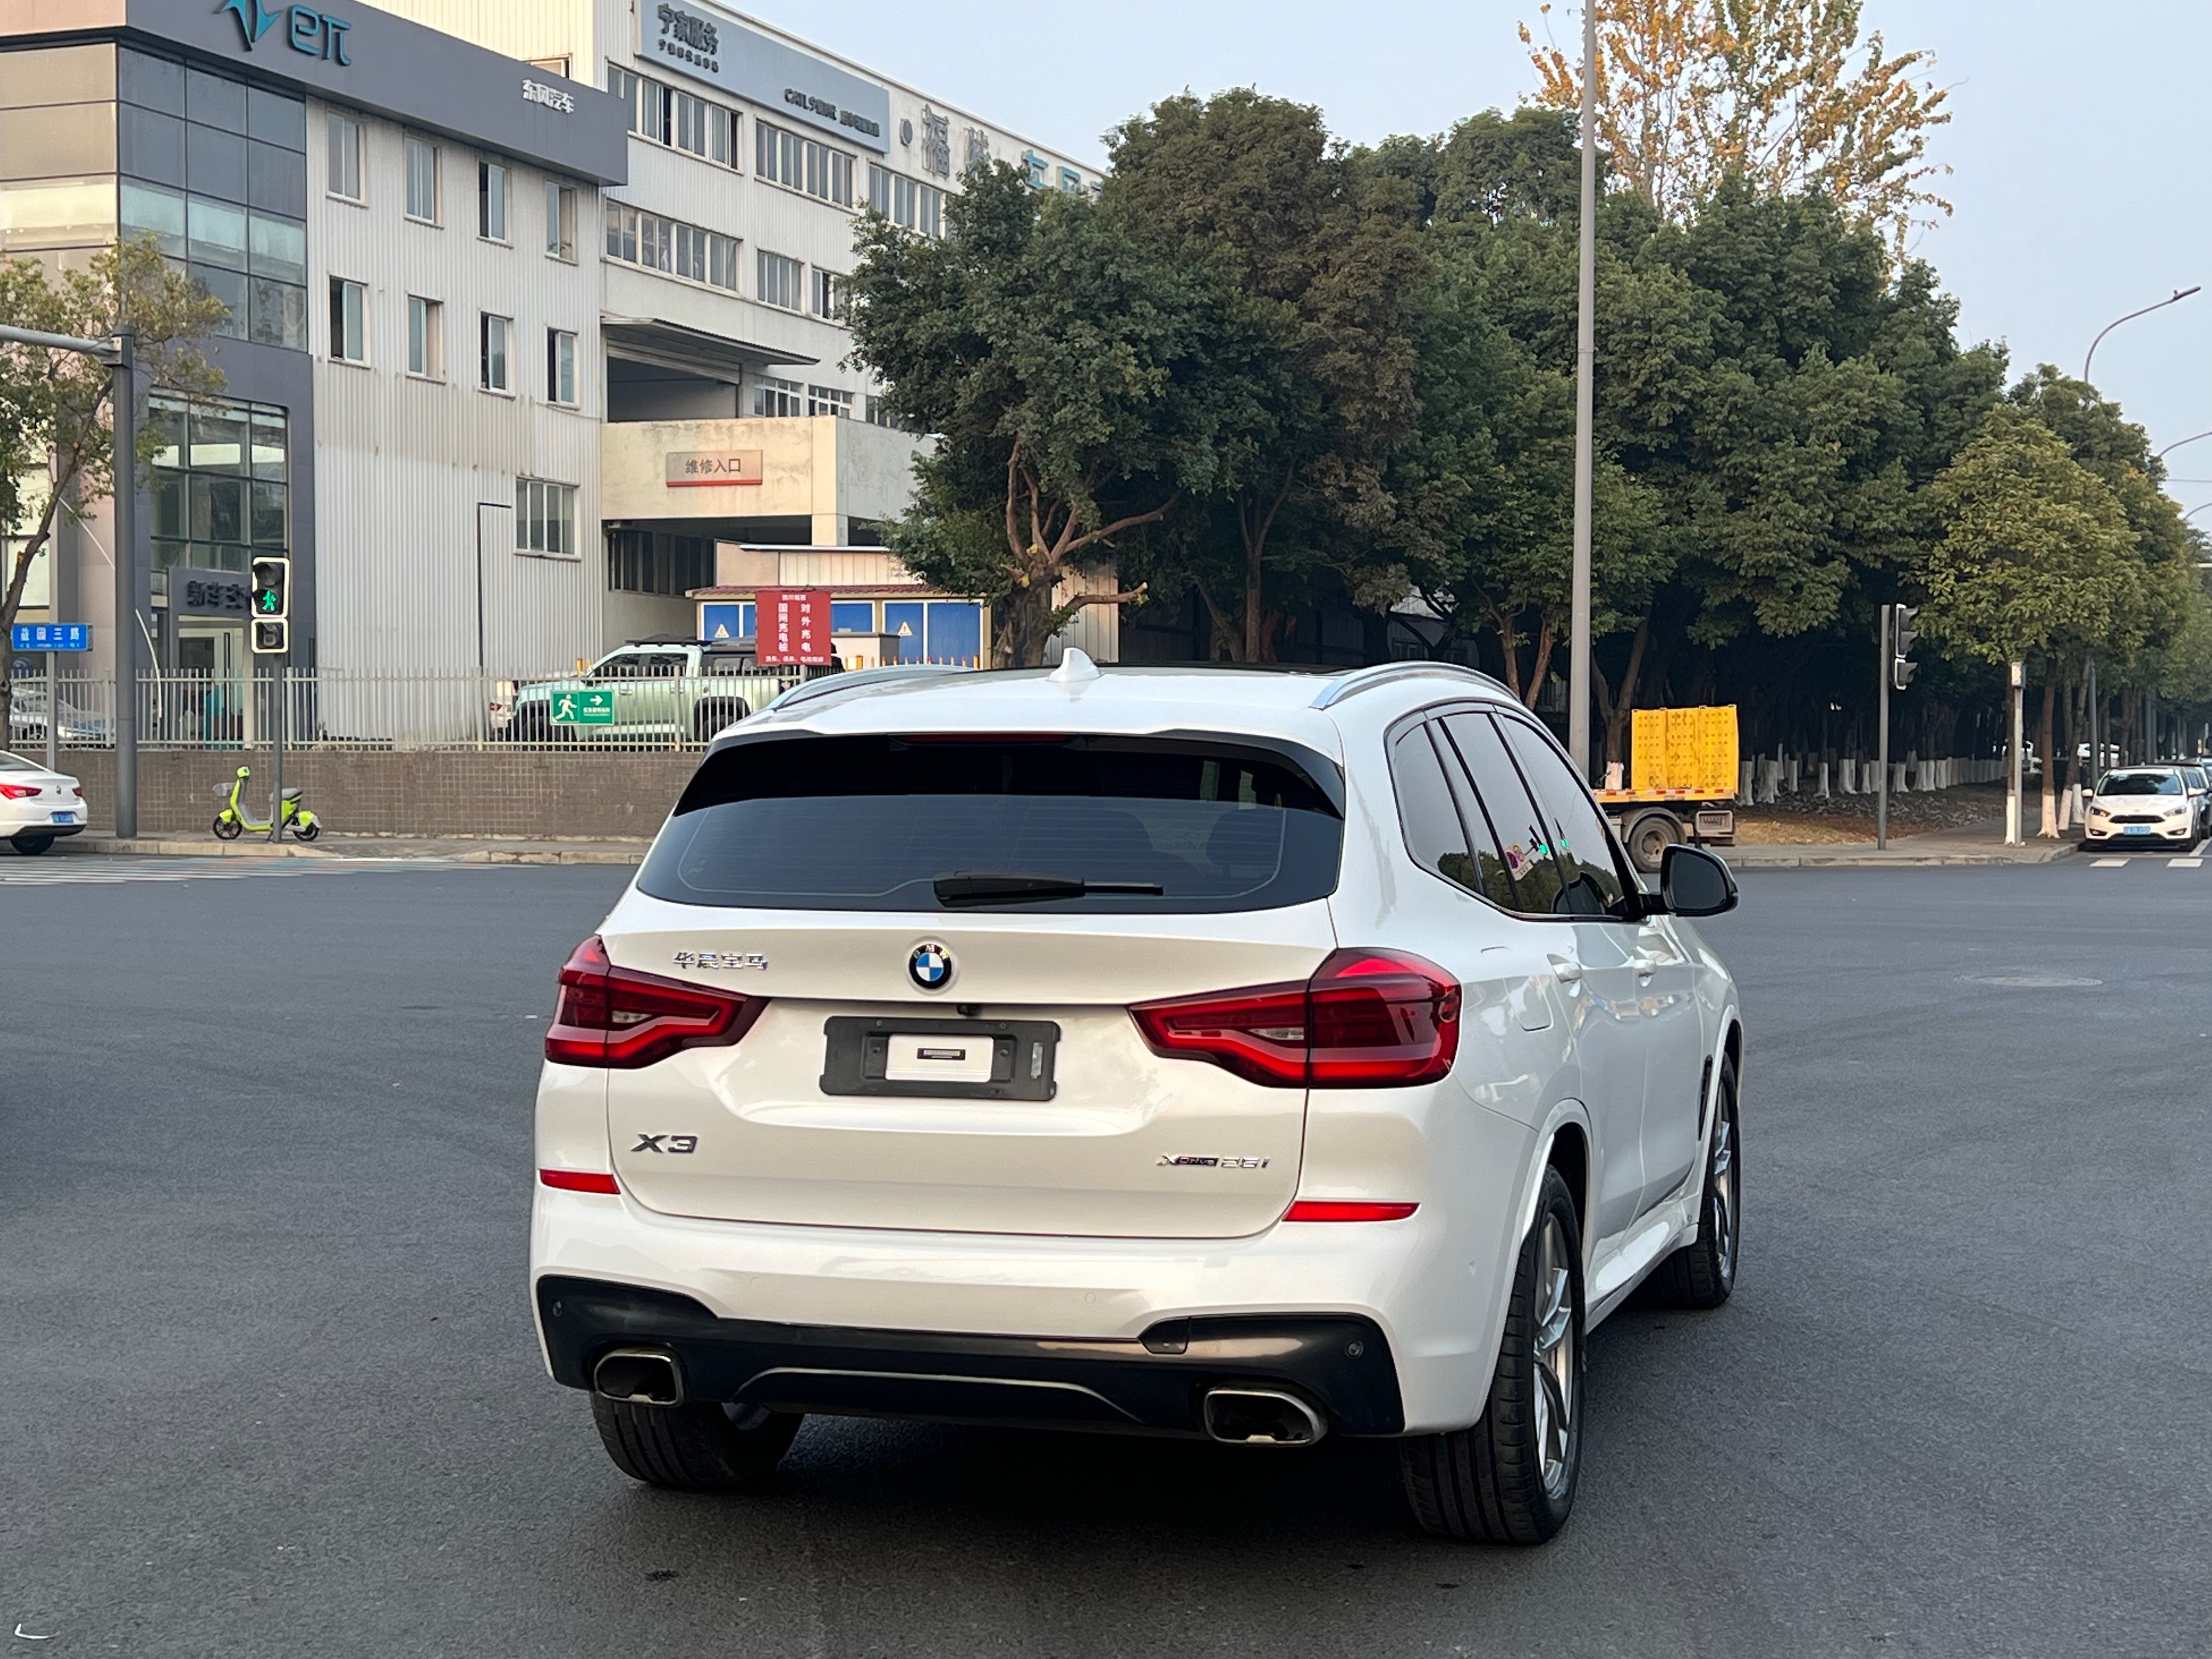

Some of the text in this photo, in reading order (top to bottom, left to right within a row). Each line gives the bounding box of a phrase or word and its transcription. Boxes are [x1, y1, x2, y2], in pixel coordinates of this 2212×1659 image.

[522, 79, 574, 113] 东风汽车
[685, 458, 741, 474] 维修入口
[187, 580, 252, 610] 新车交
[800, 603, 811, 652] 对外充电
[673, 951, 768, 971] 华晨宝马
[630, 1133, 698, 1154] X3
